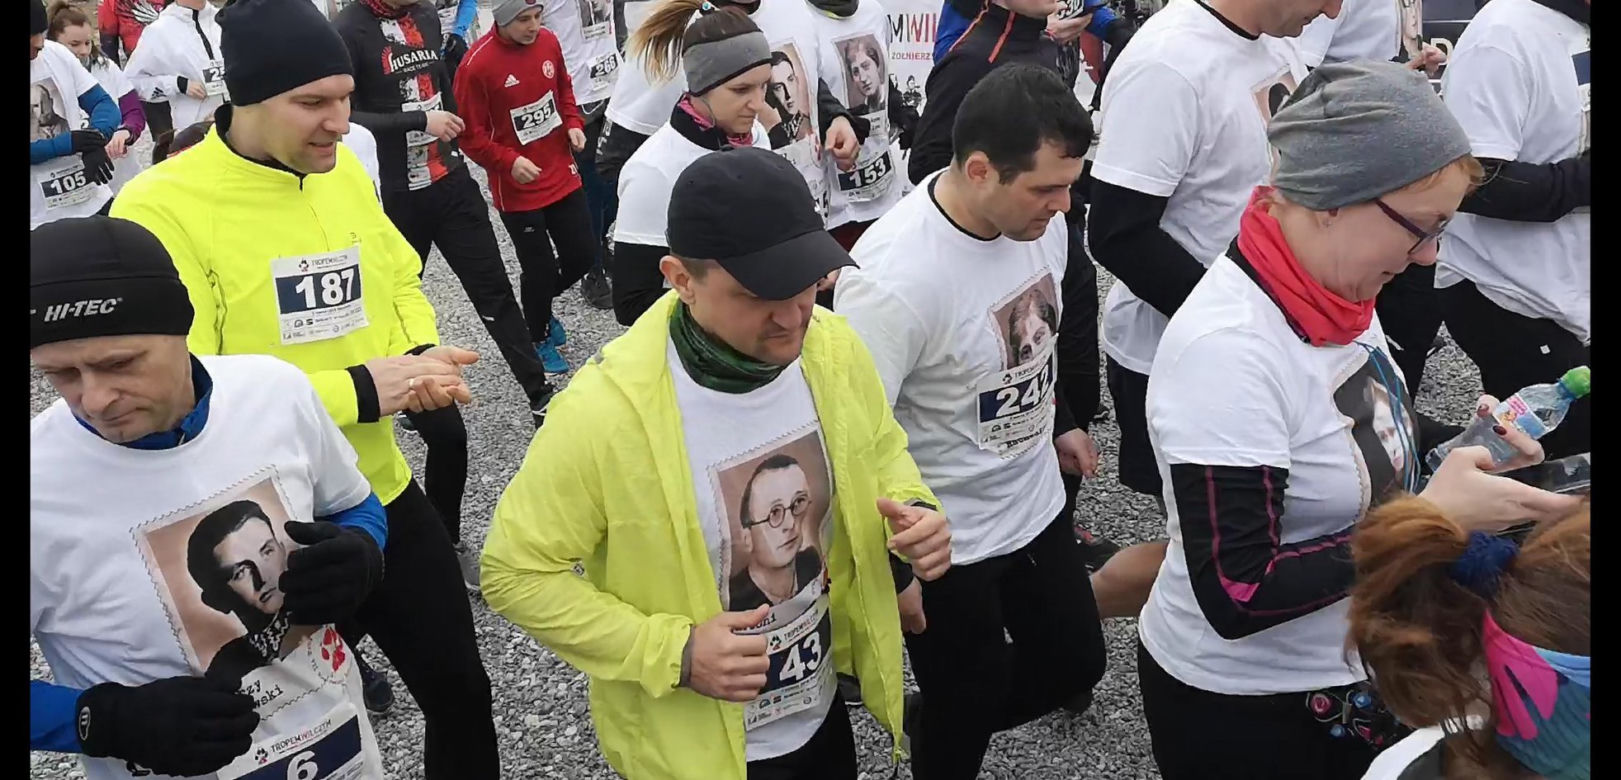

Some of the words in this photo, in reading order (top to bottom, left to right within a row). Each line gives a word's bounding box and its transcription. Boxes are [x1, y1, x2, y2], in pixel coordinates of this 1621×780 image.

[388, 50, 438, 72] HUSARIA
[521, 103, 551, 129] 295
[50, 171, 87, 194] 105
[850, 158, 887, 187] 153
[295, 268, 354, 309] 187
[43, 298, 117, 322] HI-TEC
[996, 364, 1049, 418] 242
[779, 631, 822, 681] 43
[286, 750, 319, 780] 6
